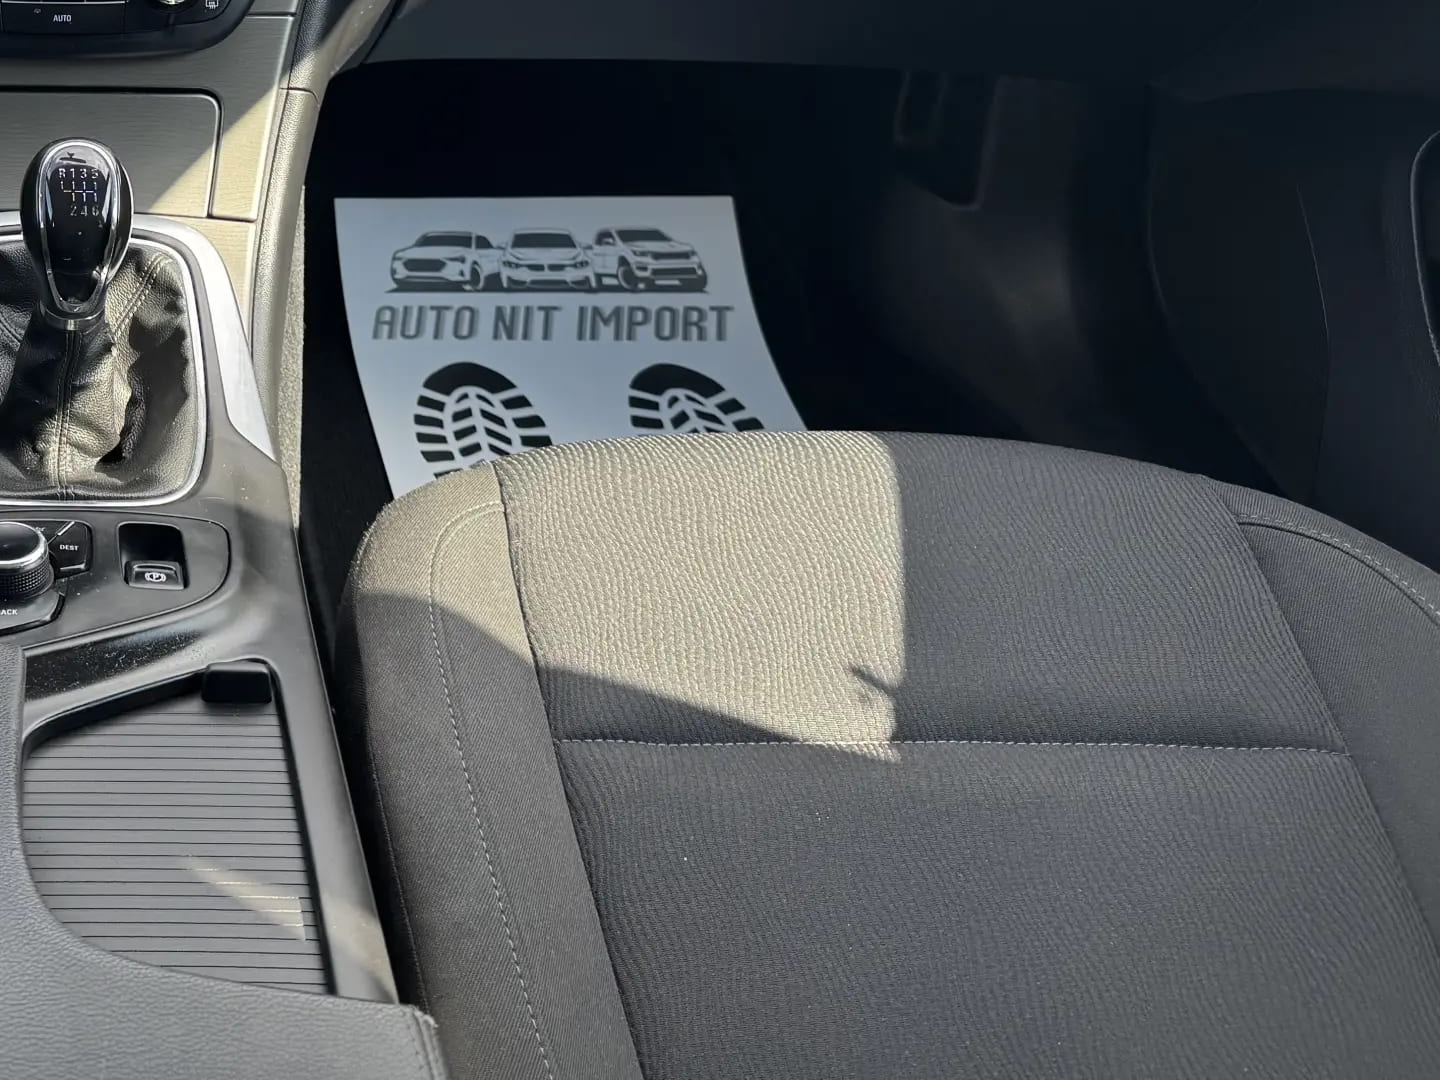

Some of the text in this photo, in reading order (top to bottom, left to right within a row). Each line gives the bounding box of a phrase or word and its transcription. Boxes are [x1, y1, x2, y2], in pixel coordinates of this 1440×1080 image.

[53, 14, 72, 23] AUTO
[372, 304, 735, 342] AUTO NIT IMPORT
